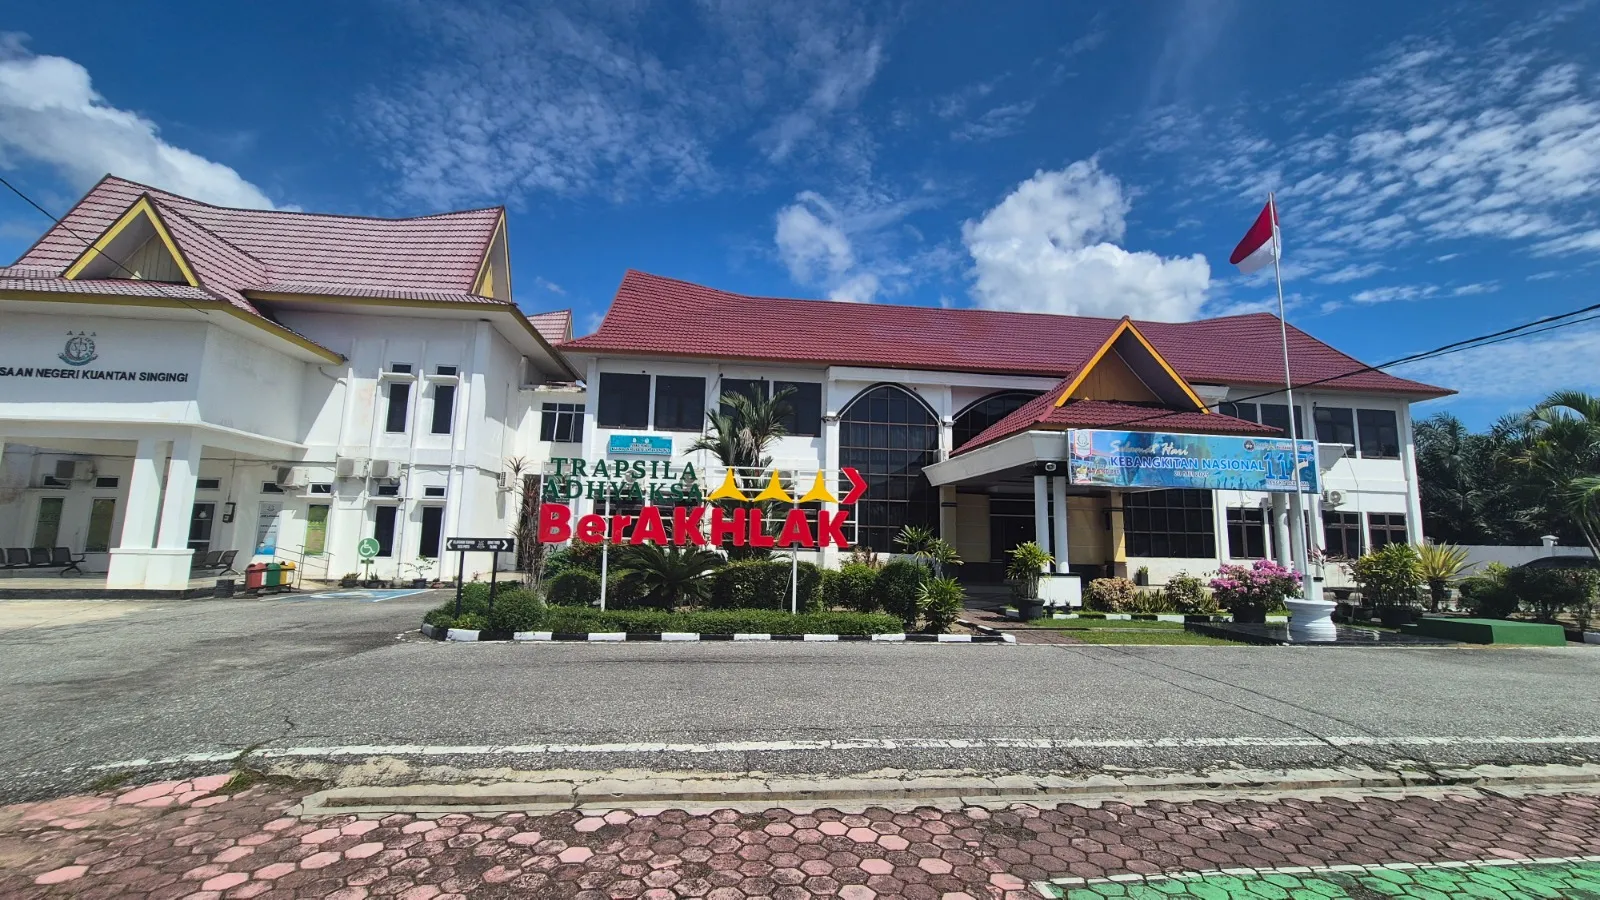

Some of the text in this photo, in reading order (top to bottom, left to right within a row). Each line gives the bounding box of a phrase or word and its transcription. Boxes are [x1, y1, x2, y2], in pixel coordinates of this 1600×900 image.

[35, 368, 79, 379] NEGERI
[82, 370, 136, 381] KUANTAN
[139, 372, 188, 382] SINGINGI
[1161, 442, 1189, 456] Hari
[551, 457, 698, 480] TRAPSILA
[1110, 456, 1265, 471] KEBANGKITAN NASIONAL
[541, 479, 703, 502] ADHYAKSA
[538, 503, 849, 547] BerAKHLAK
